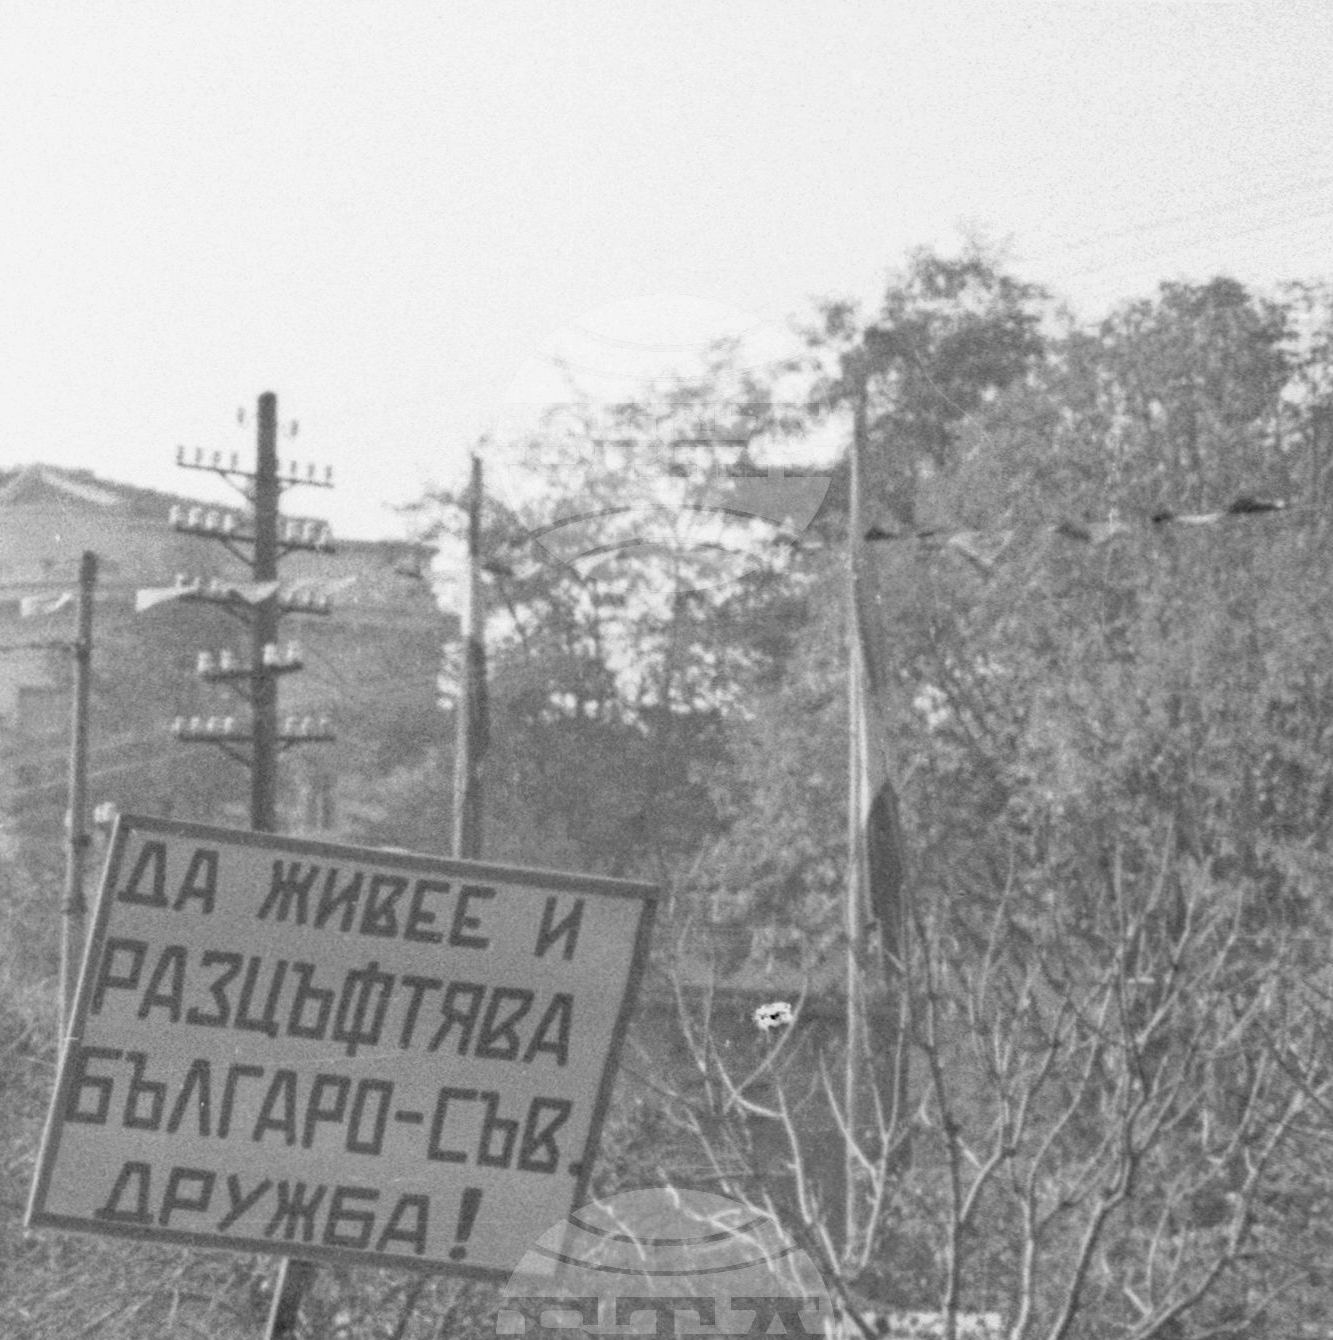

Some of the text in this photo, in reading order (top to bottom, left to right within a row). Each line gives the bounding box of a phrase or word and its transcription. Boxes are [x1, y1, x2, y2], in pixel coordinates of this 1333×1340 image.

[118, 840, 587, 962] ДА ЖИВЕЕ И
[91, 937, 575, 1067] РАЗЦЪФТЯВА
[64, 1046, 590, 1178] БЪЛГАРО-СЪВ.
[94, 1160, 485, 1262] ДРУЖБА!
